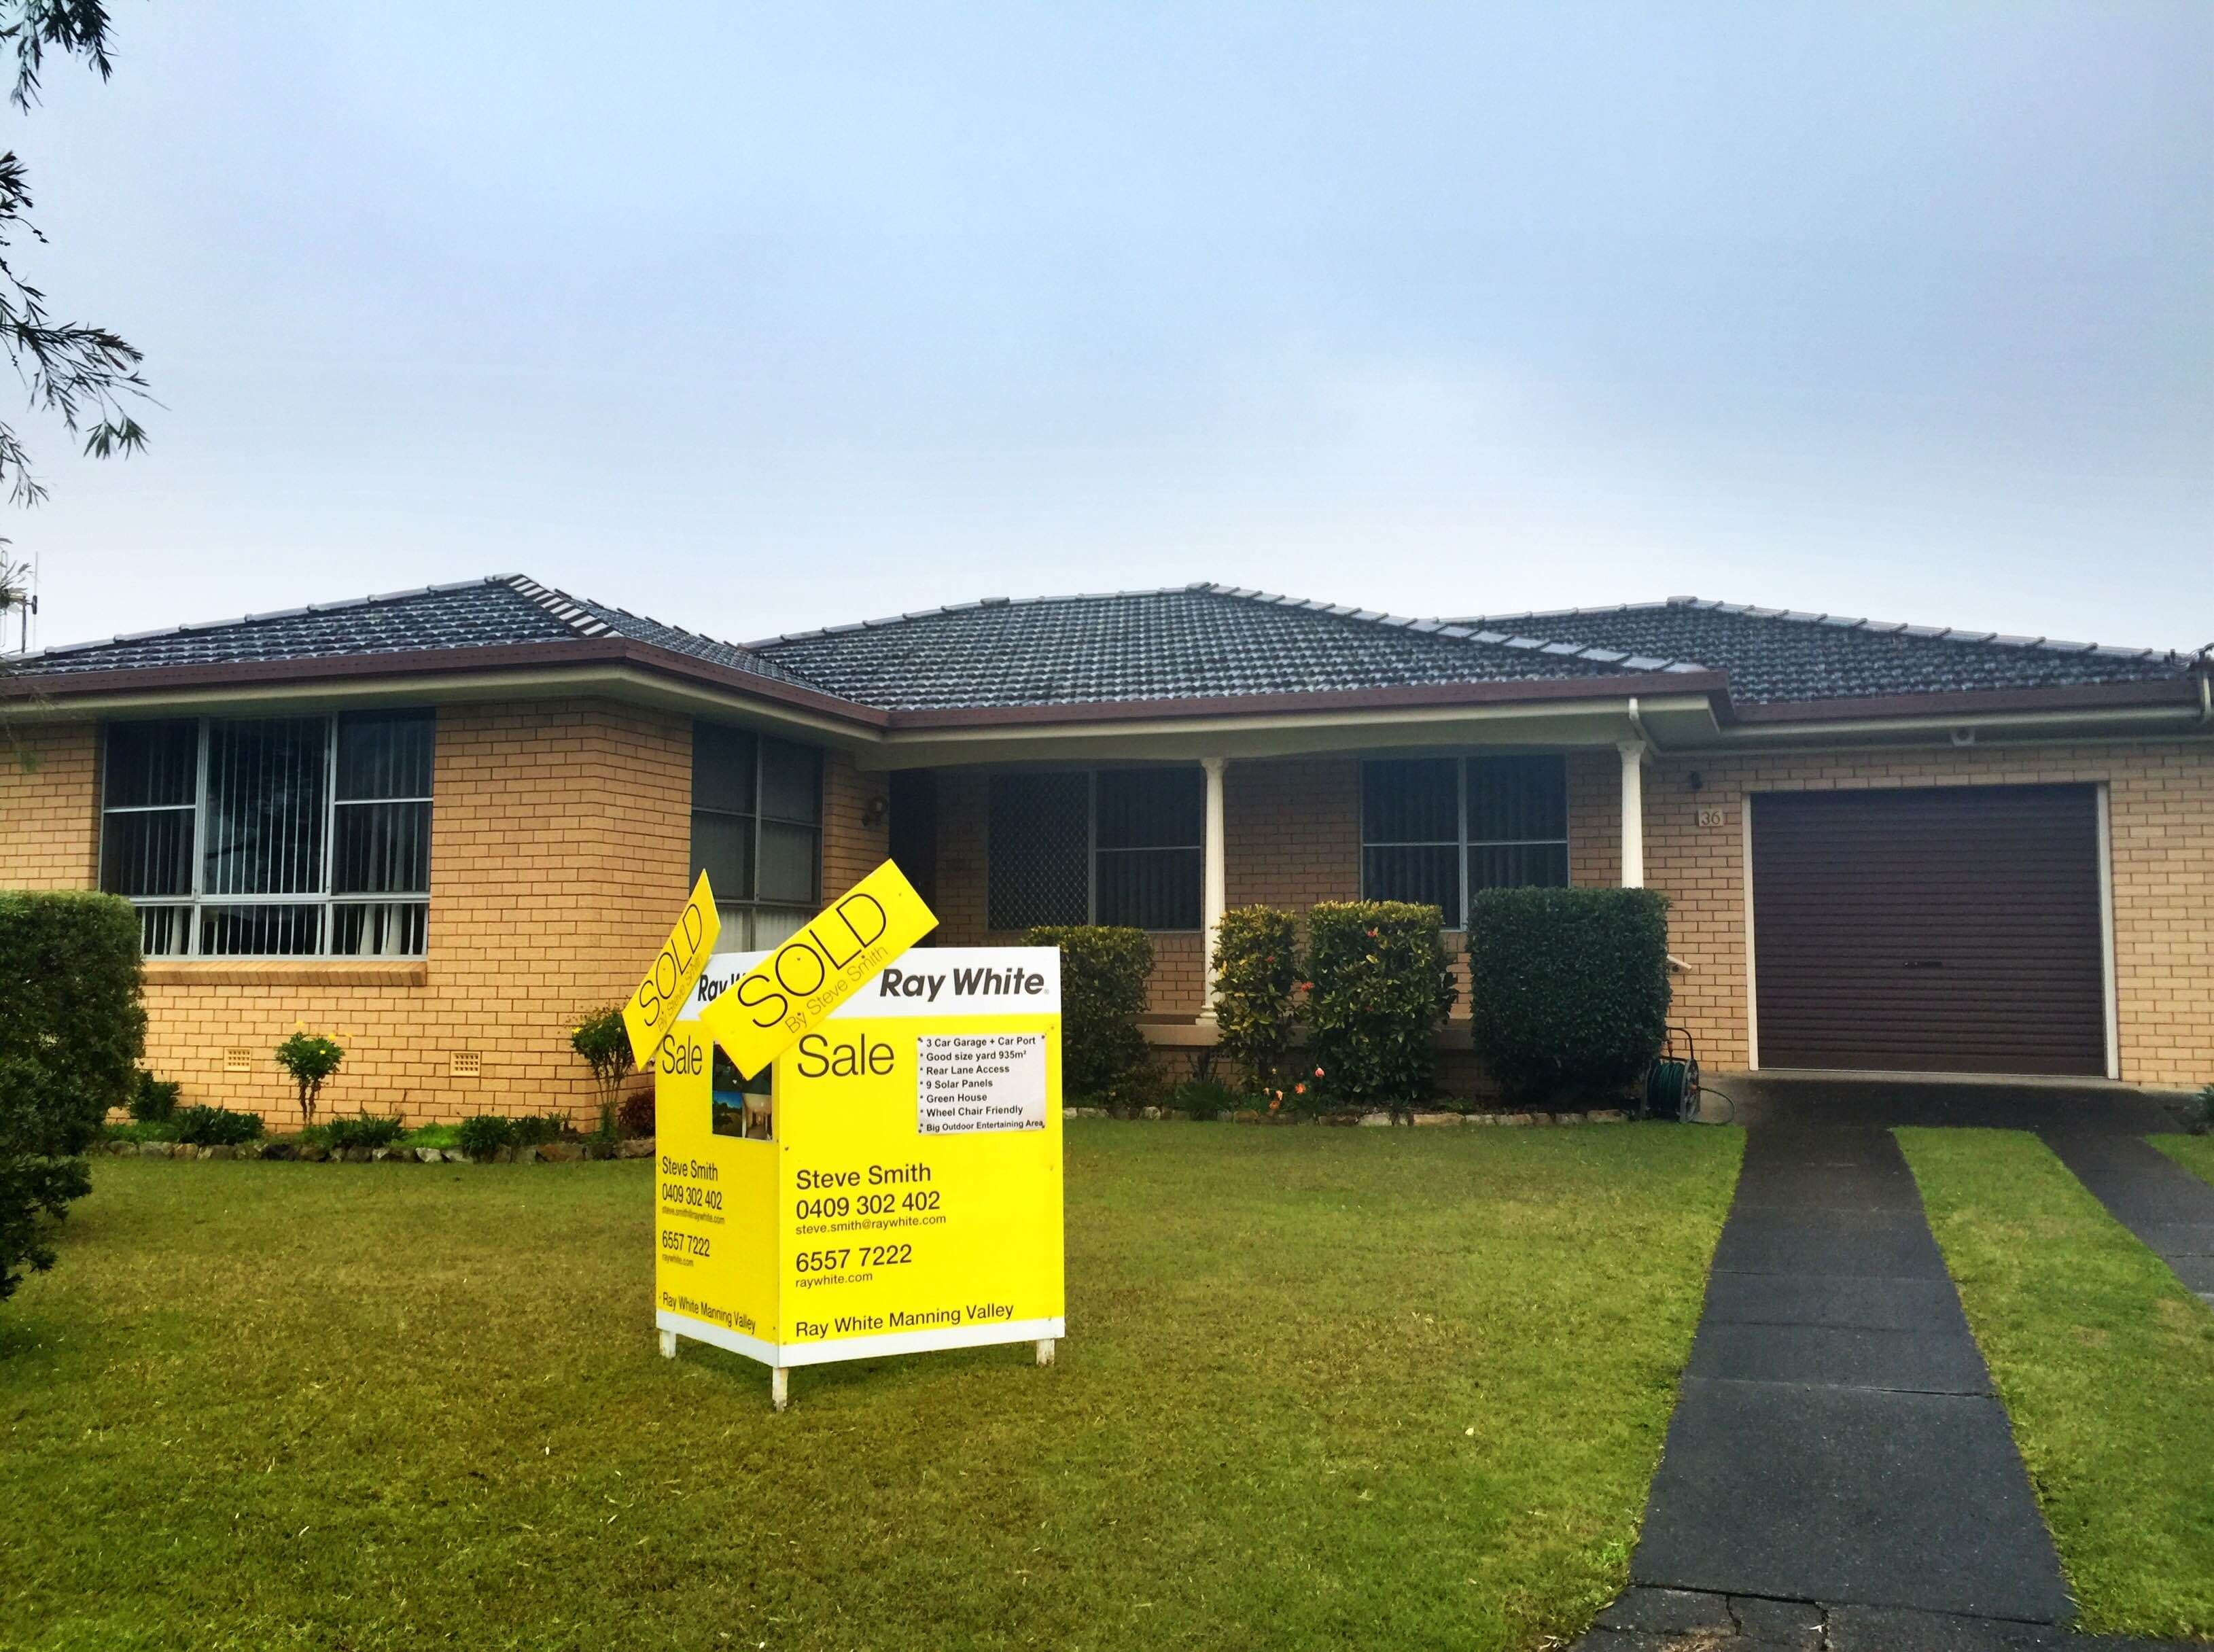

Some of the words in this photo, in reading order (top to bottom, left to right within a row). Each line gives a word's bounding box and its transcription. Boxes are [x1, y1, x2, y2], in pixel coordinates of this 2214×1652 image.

[1701, 810, 1721, 825] 36
[639, 903, 702, 1026] SOLD
[737, 893, 886, 1027] SOLD
[784, 1014, 807, 1034] By
[807, 979, 848, 1016] Steve
[847, 945, 889, 983] Smith
[879, 968, 946, 1002] Ray
[953, 967, 1044, 996] White
[662, 1034, 702, 1074] Sale
[797, 1033, 894, 1078] Sale
[926, 1038, 932, 1047] 3
[934, 1038, 951, 1047] Car
[953, 1038, 987, 1048] Garage
[998, 1037, 1014, 1046] Car
[1017, 1036, 1036, 1045] Port
[926, 1052, 952, 1061] Good
[954, 1051, 973, 1060] size
[976, 1051, 996, 1061] yard
[926, 1066, 948, 1075] Rear
[951, 1066, 974, 1074] Lane
[976, 1065, 1010, 1074] Access
[926, 1080, 932, 1089] 9
[934, 1079, 959, 1089] Solar
[962, 1078, 994, 1088] Panels
[926, 1094, 955, 1103] Green
[957, 1093, 987, 1102] House
[926, 1108, 955, 1117] Wheel
[957, 1107, 983, 1116] Chair
[985, 1105, 1023, 1116] Friendly
[926, 1123, 940, 1133] Big
[942, 1121, 974, 1131] Outdoor
[977, 1120, 1023, 1129] Entertaining
[1025, 1119, 1043, 1127] Area
[662, 1155, 688, 1177] Steve
[690, 1159, 718, 1182] Smith
[796, 1170, 860, 1190] Steve
[868, 1163, 932, 1185] Smith
[662, 1182, 684, 1203] 0409
[686, 1187, 703, 1207] 302
[705, 1190, 722, 1210] 402
[796, 1197, 849, 1220] 0409
[856, 1193, 896, 1215] 302
[902, 1191, 941, 1211] 402
[795, 1215, 947, 1235] steve.smith@raywhite.com
[662, 1230, 684, 1251] 6557
[687, 1235, 710, 1257] 7222
[796, 1248, 850, 1273] 6557
[858, 1244, 912, 1267] 7222
[795, 1272, 873, 1289] raywhite.com
[663, 1292, 677, 1312] Ray
[678, 1295, 699, 1314] White
[701, 1302, 732, 1328] Manning
[734, 1310, 756, 1335] Valley
[796, 1321, 828, 1339] Ray
[834, 1316, 883, 1333] White
[889, 1308, 961, 1328] Manning
[966, 1303, 1015, 1320] Valley
